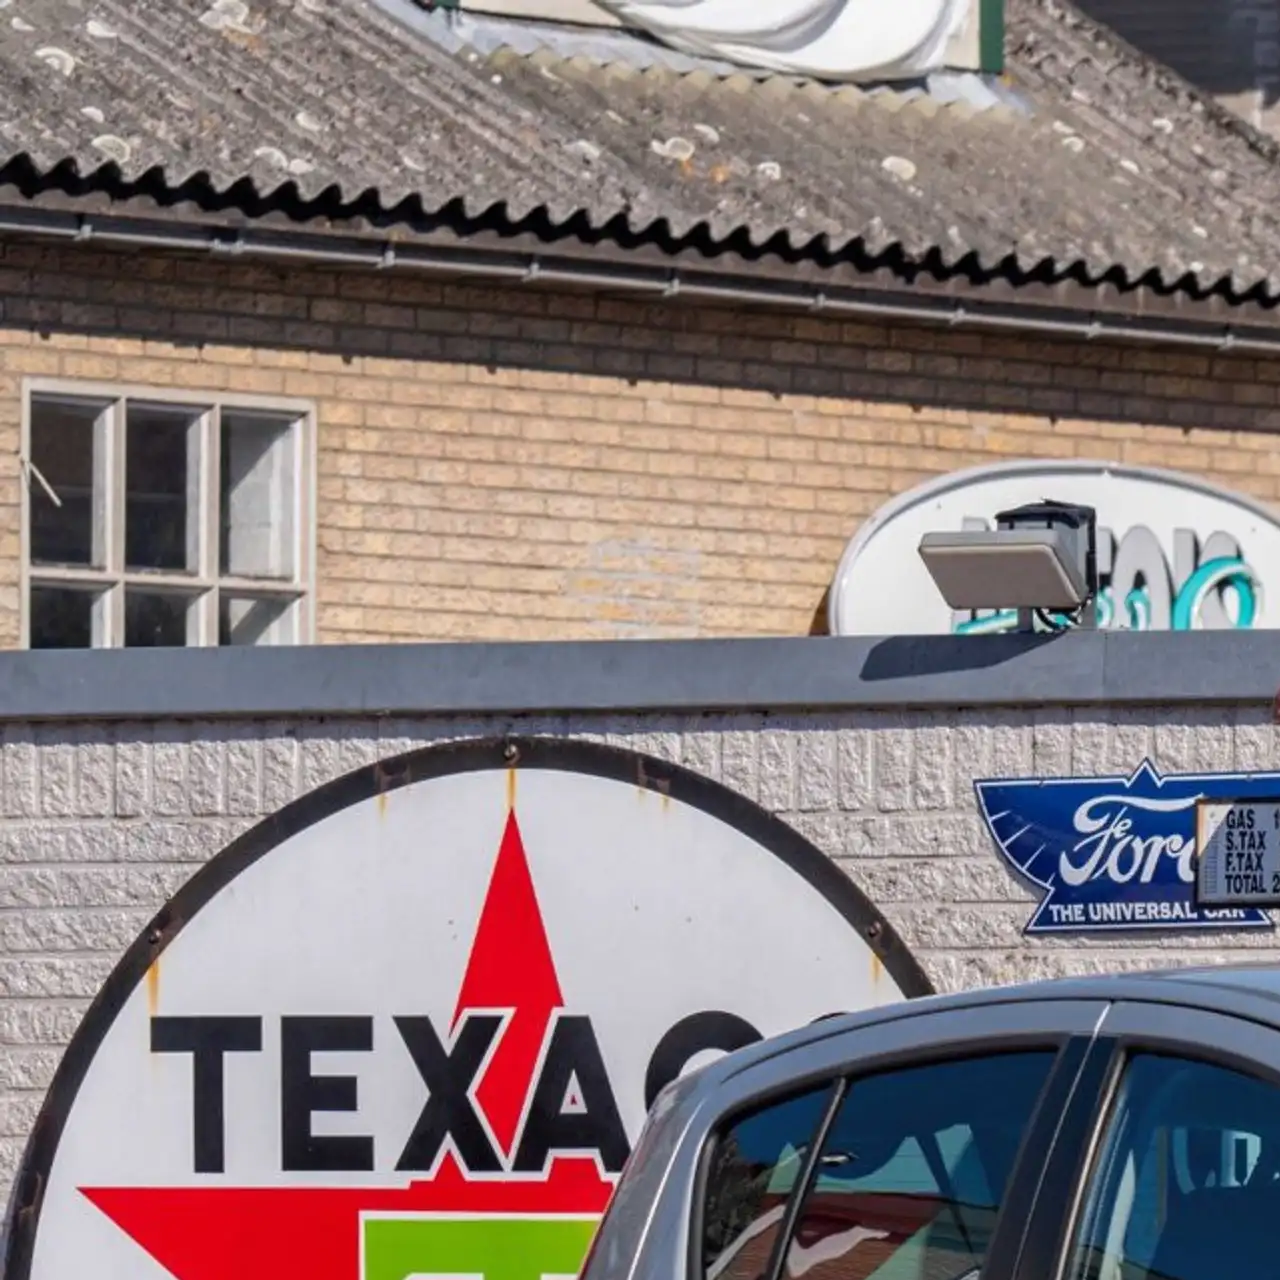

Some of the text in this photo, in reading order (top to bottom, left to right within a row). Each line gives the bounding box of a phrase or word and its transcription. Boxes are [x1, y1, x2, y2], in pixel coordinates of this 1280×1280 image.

[1225, 808, 1256, 830] GAS
[1225, 830, 1267, 851] S.TAX
[1225, 852, 1264, 873] F.TAX
[1224, 873, 1267, 895] TOTAL
[1048, 904, 1085, 923] THE
[1087, 900, 1198, 922] UNIVERSAL
[149, 1009, 848, 1173] TEXA
